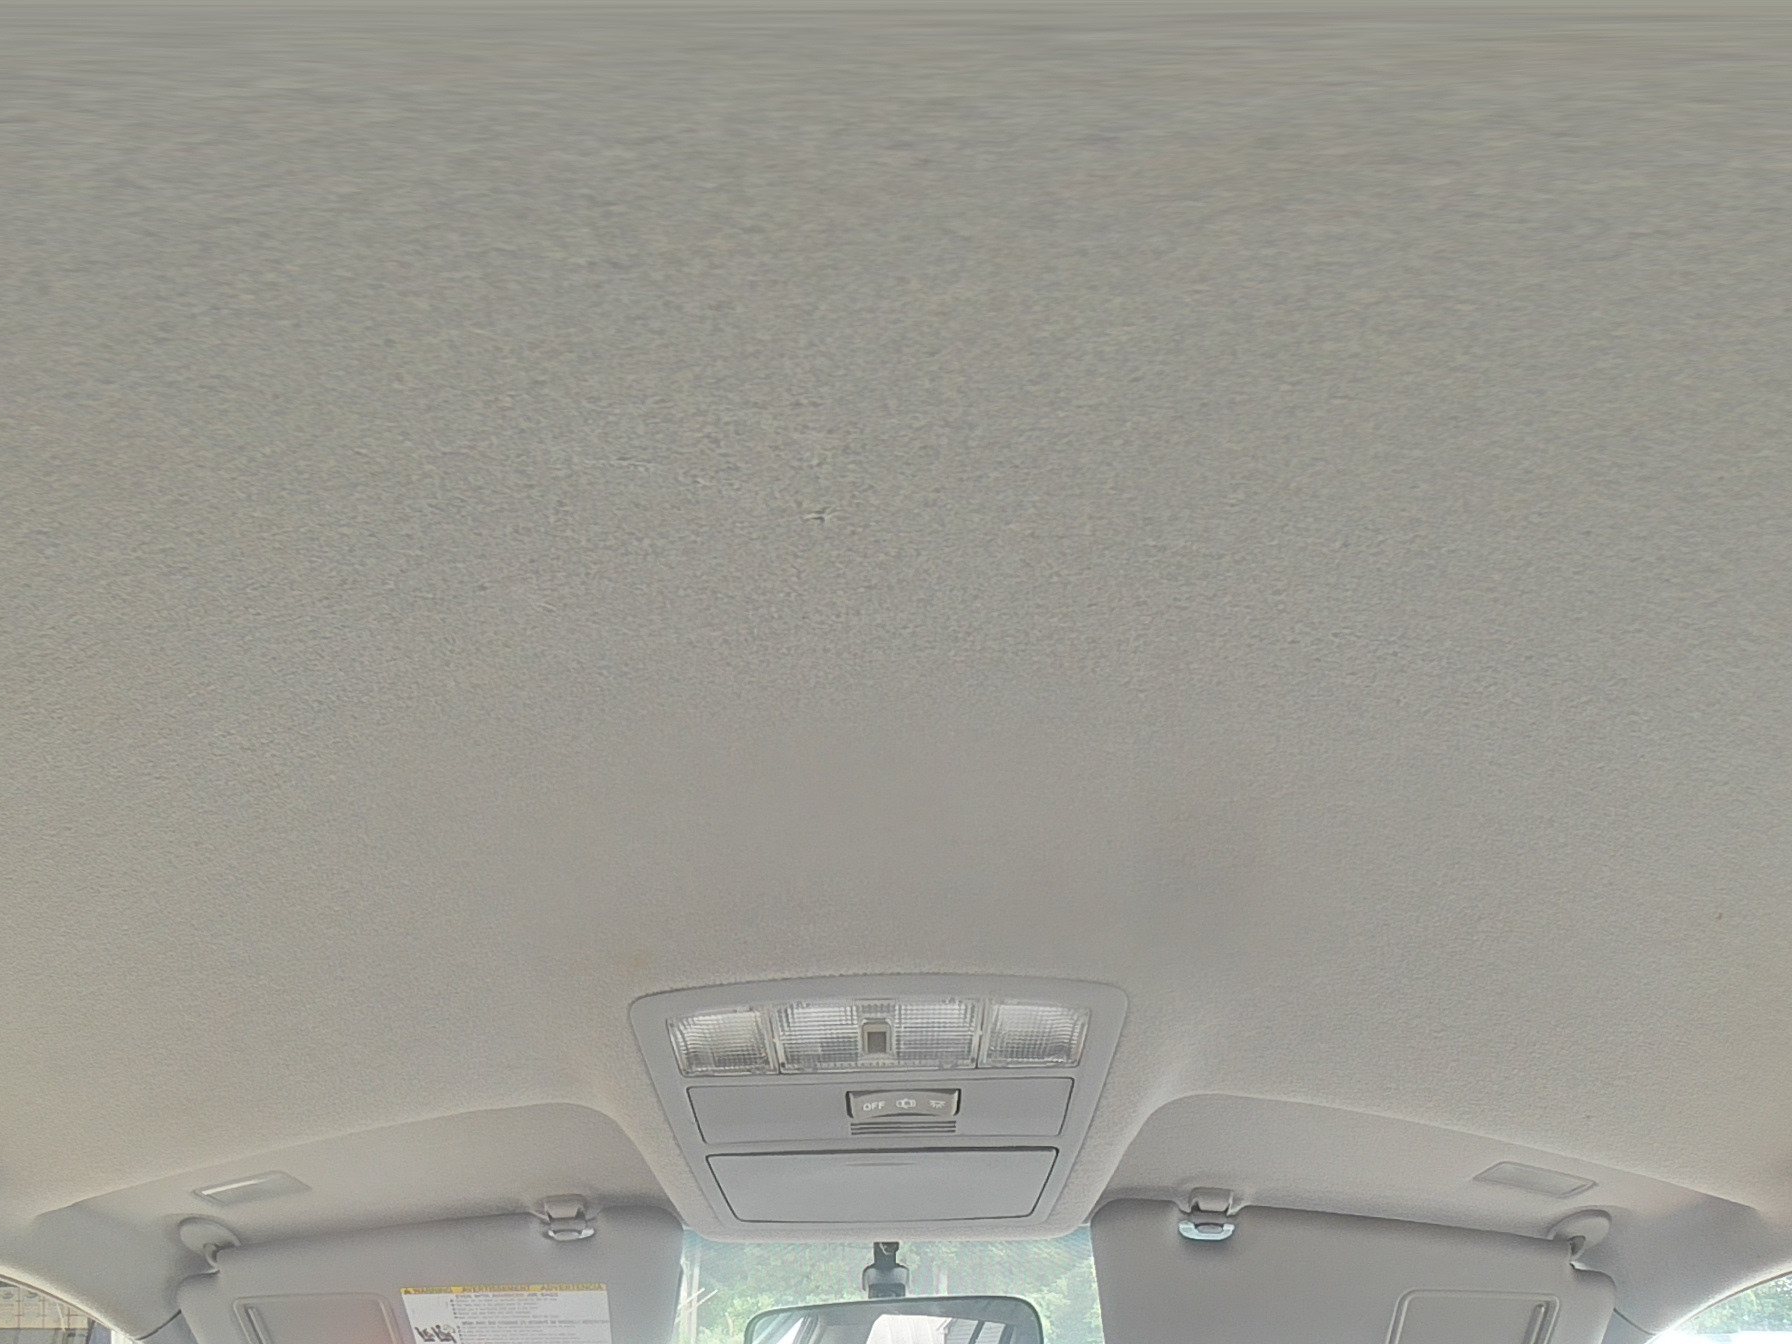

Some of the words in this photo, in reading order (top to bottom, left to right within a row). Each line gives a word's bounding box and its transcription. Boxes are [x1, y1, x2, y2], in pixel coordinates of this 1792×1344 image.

[863, 1101, 886, 1111] OFF
[462, 1285, 530, 1293] AVERTISSEMENT
[540, 1284, 603, 1292] ADVERTENCIA
